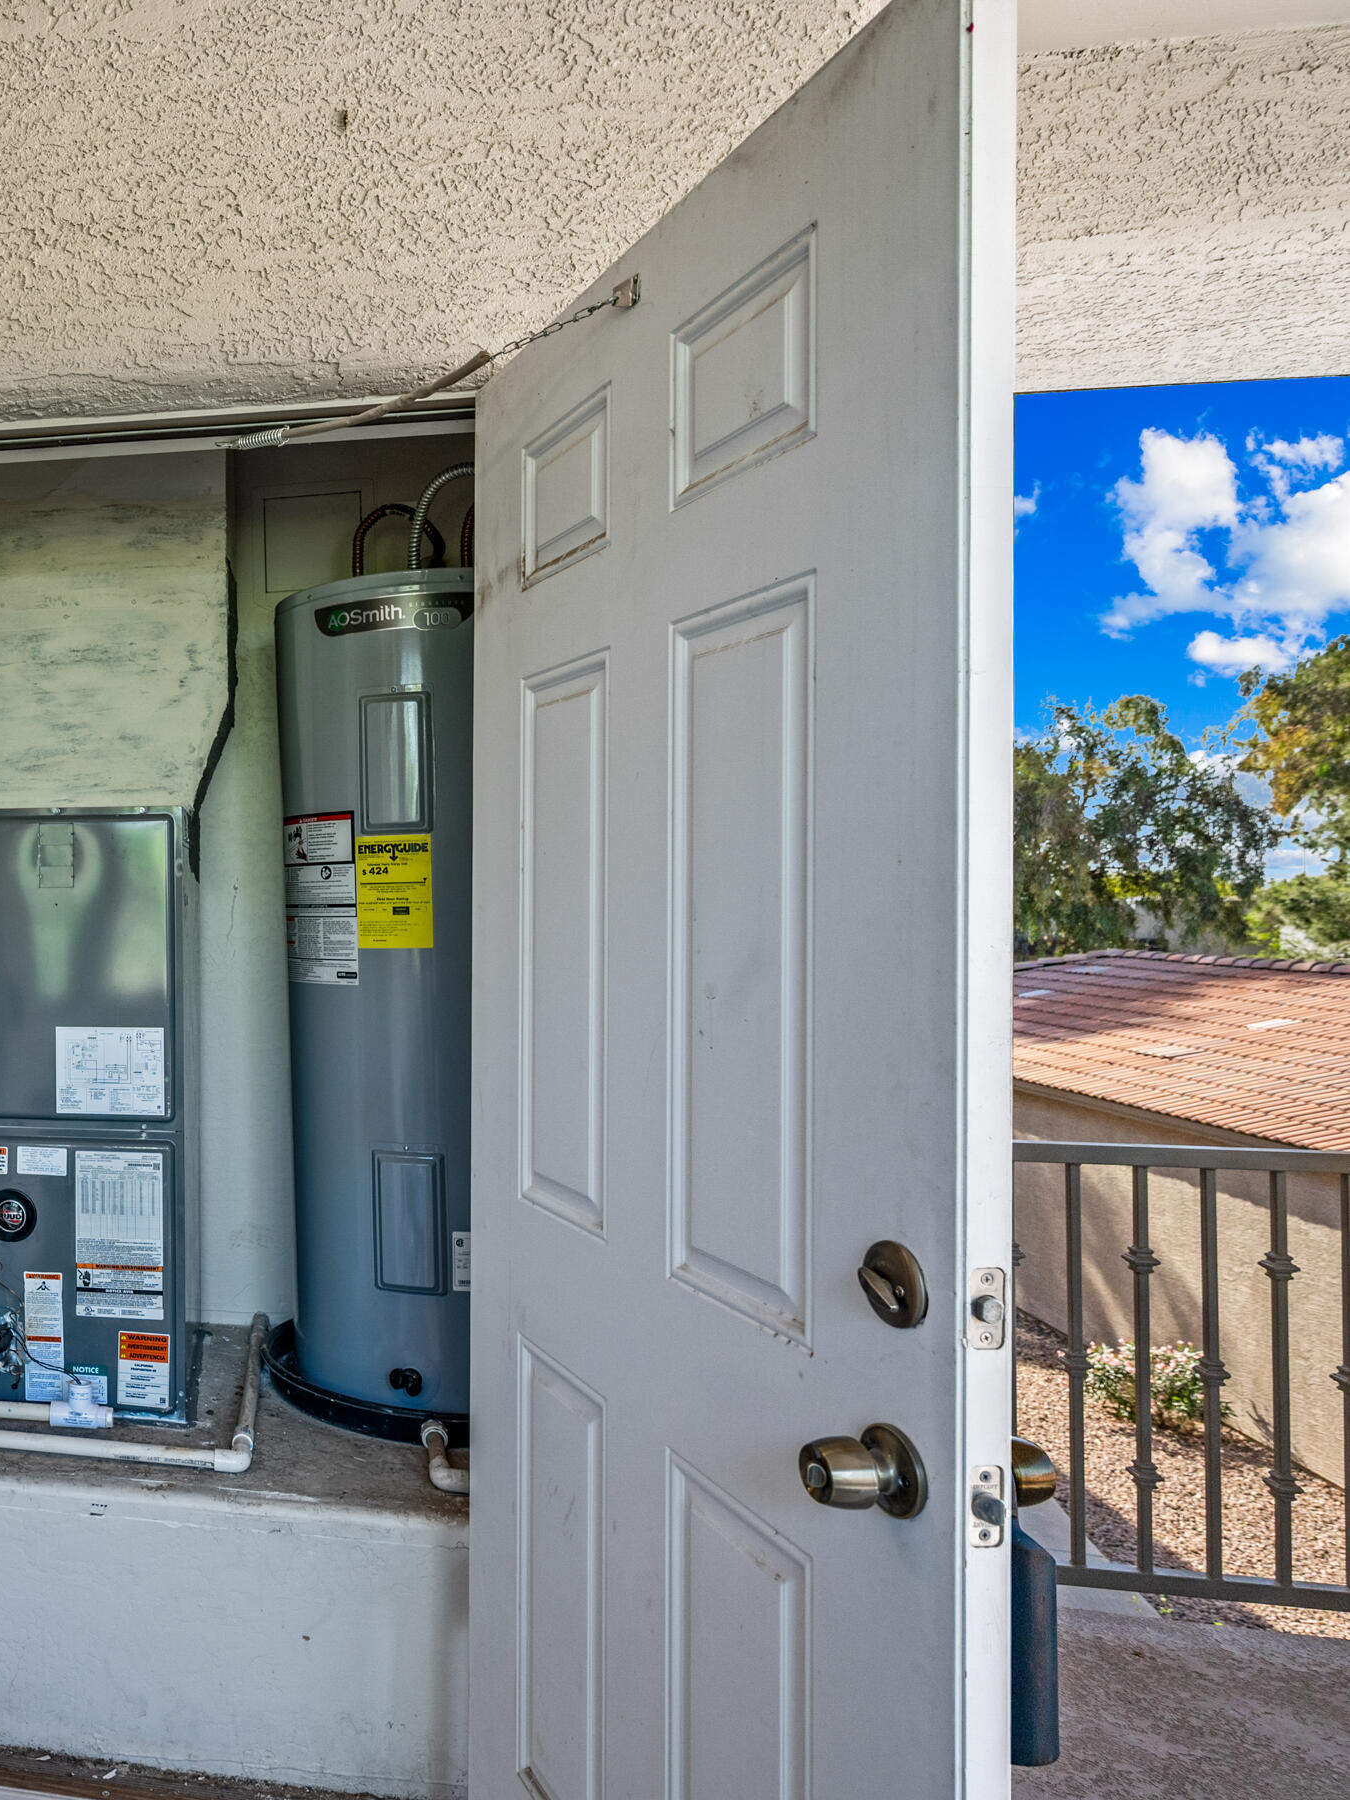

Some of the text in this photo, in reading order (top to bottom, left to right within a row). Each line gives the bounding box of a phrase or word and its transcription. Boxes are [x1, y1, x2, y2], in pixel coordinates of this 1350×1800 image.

[423, 611, 451, 626] 100
[358, 842, 429, 857] ENERGYGUIDE
[369, 866, 389, 875] 424
[127, 1334, 167, 1343] WARNING
[130, 1352, 166, 1361] ADVERTENCIA
[72, 1366, 99, 1374] NOTICE
